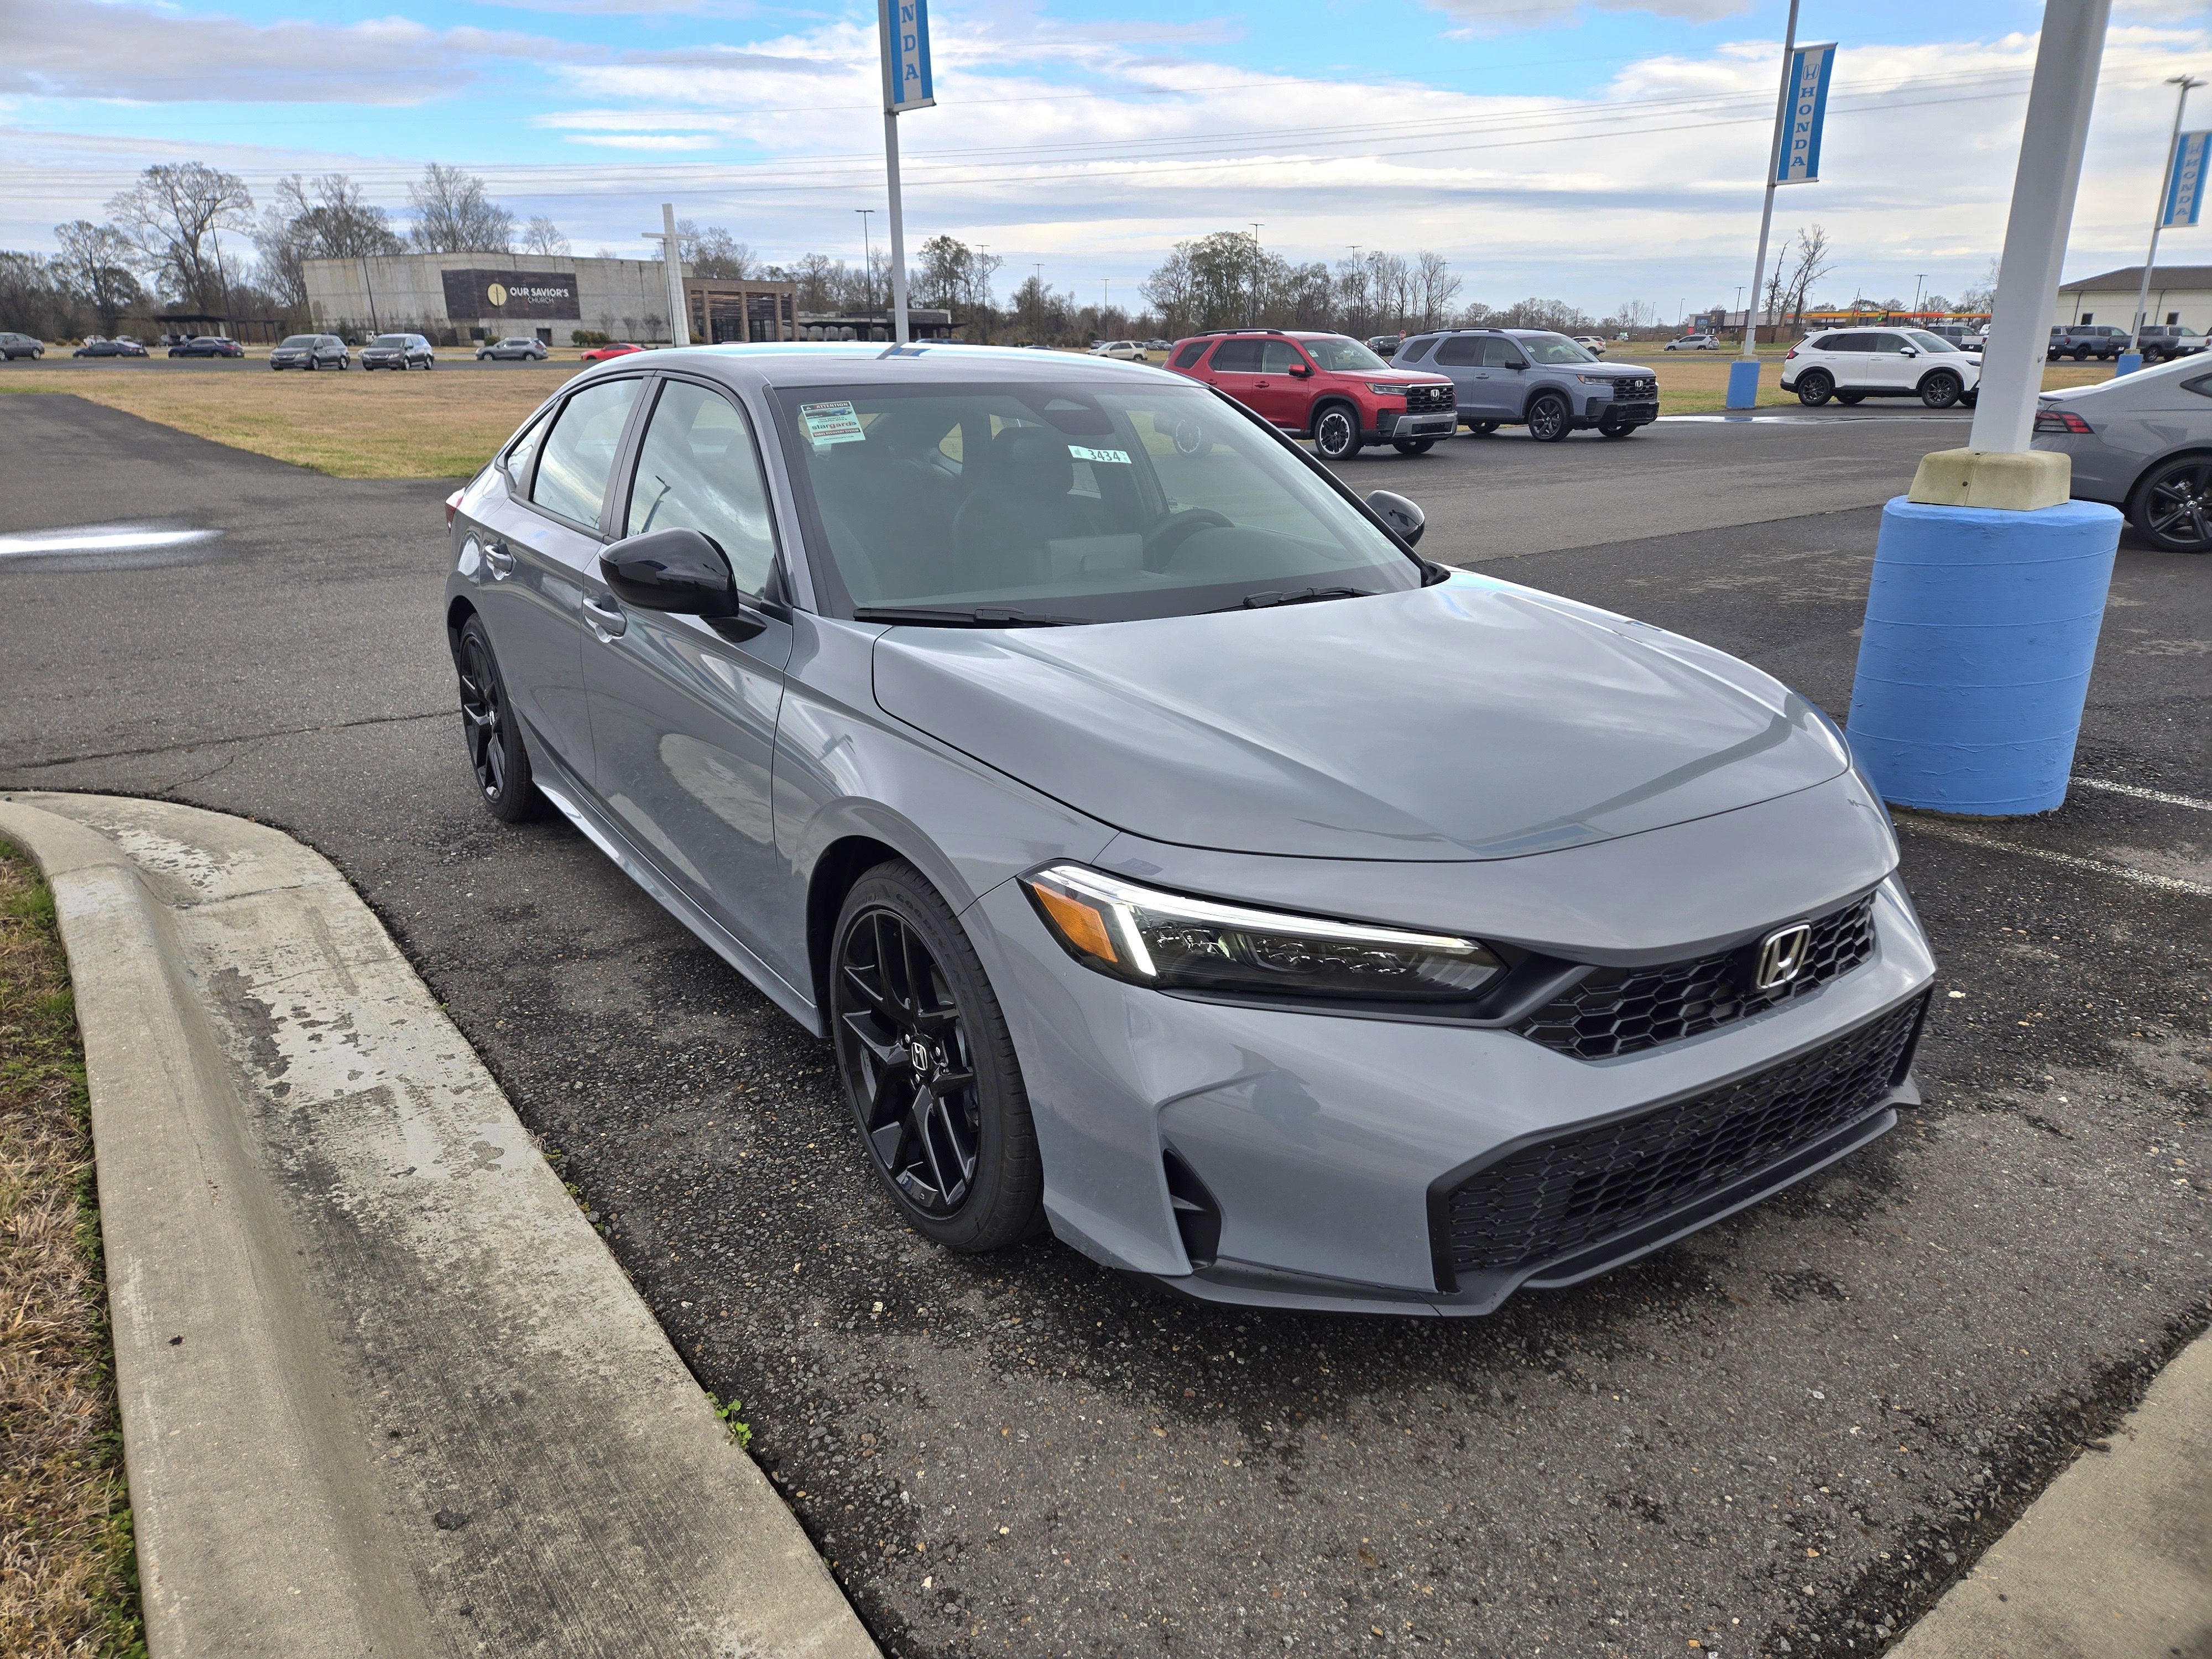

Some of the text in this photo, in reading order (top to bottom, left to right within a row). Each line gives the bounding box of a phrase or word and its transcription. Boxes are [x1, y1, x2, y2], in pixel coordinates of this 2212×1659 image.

[1791, 86, 1815, 166] HONDA
[2176, 159, 2200, 215] HONDA
[510, 287, 570, 298] OUR SAVIOR'S
[1088, 449, 1121, 461] 3434
